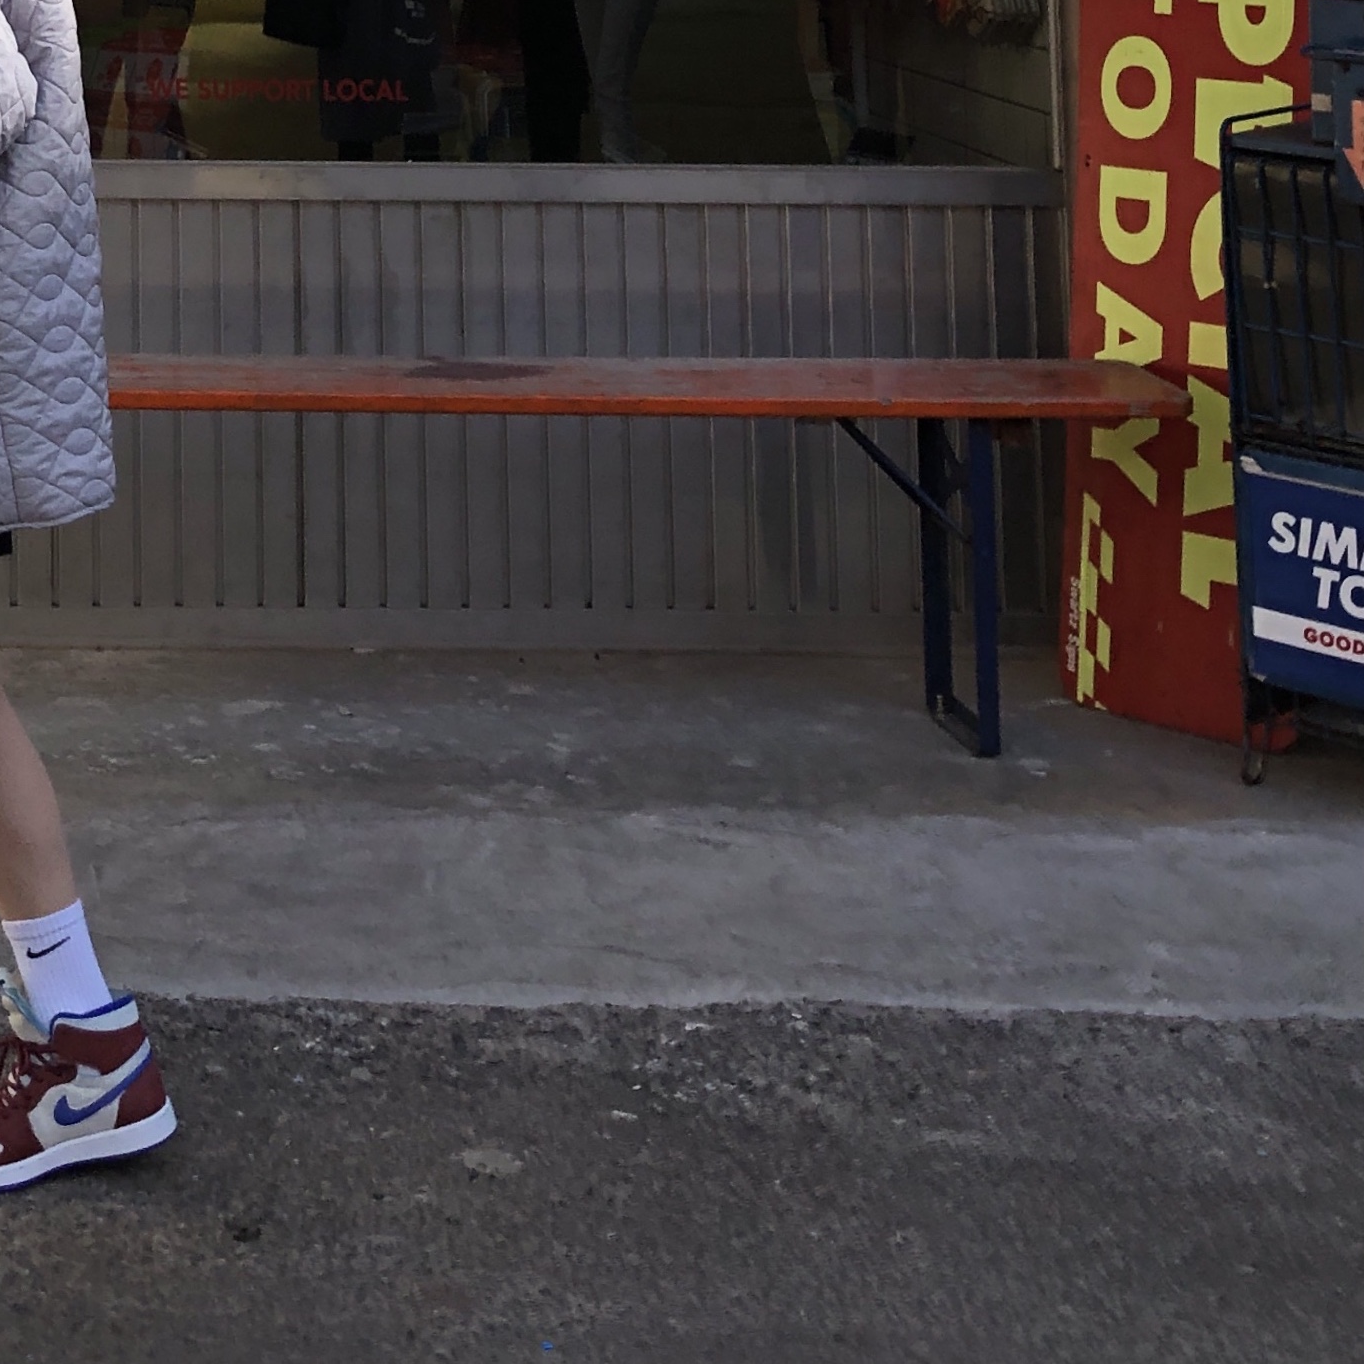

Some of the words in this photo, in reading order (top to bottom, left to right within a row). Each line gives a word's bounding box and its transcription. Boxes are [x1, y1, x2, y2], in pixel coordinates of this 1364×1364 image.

[149, 79, 190, 101] WE
[197, 79, 315, 103] SUPPORT
[323, 79, 410, 103] LOCAL
[1267, 510, 1364, 571] SIM
